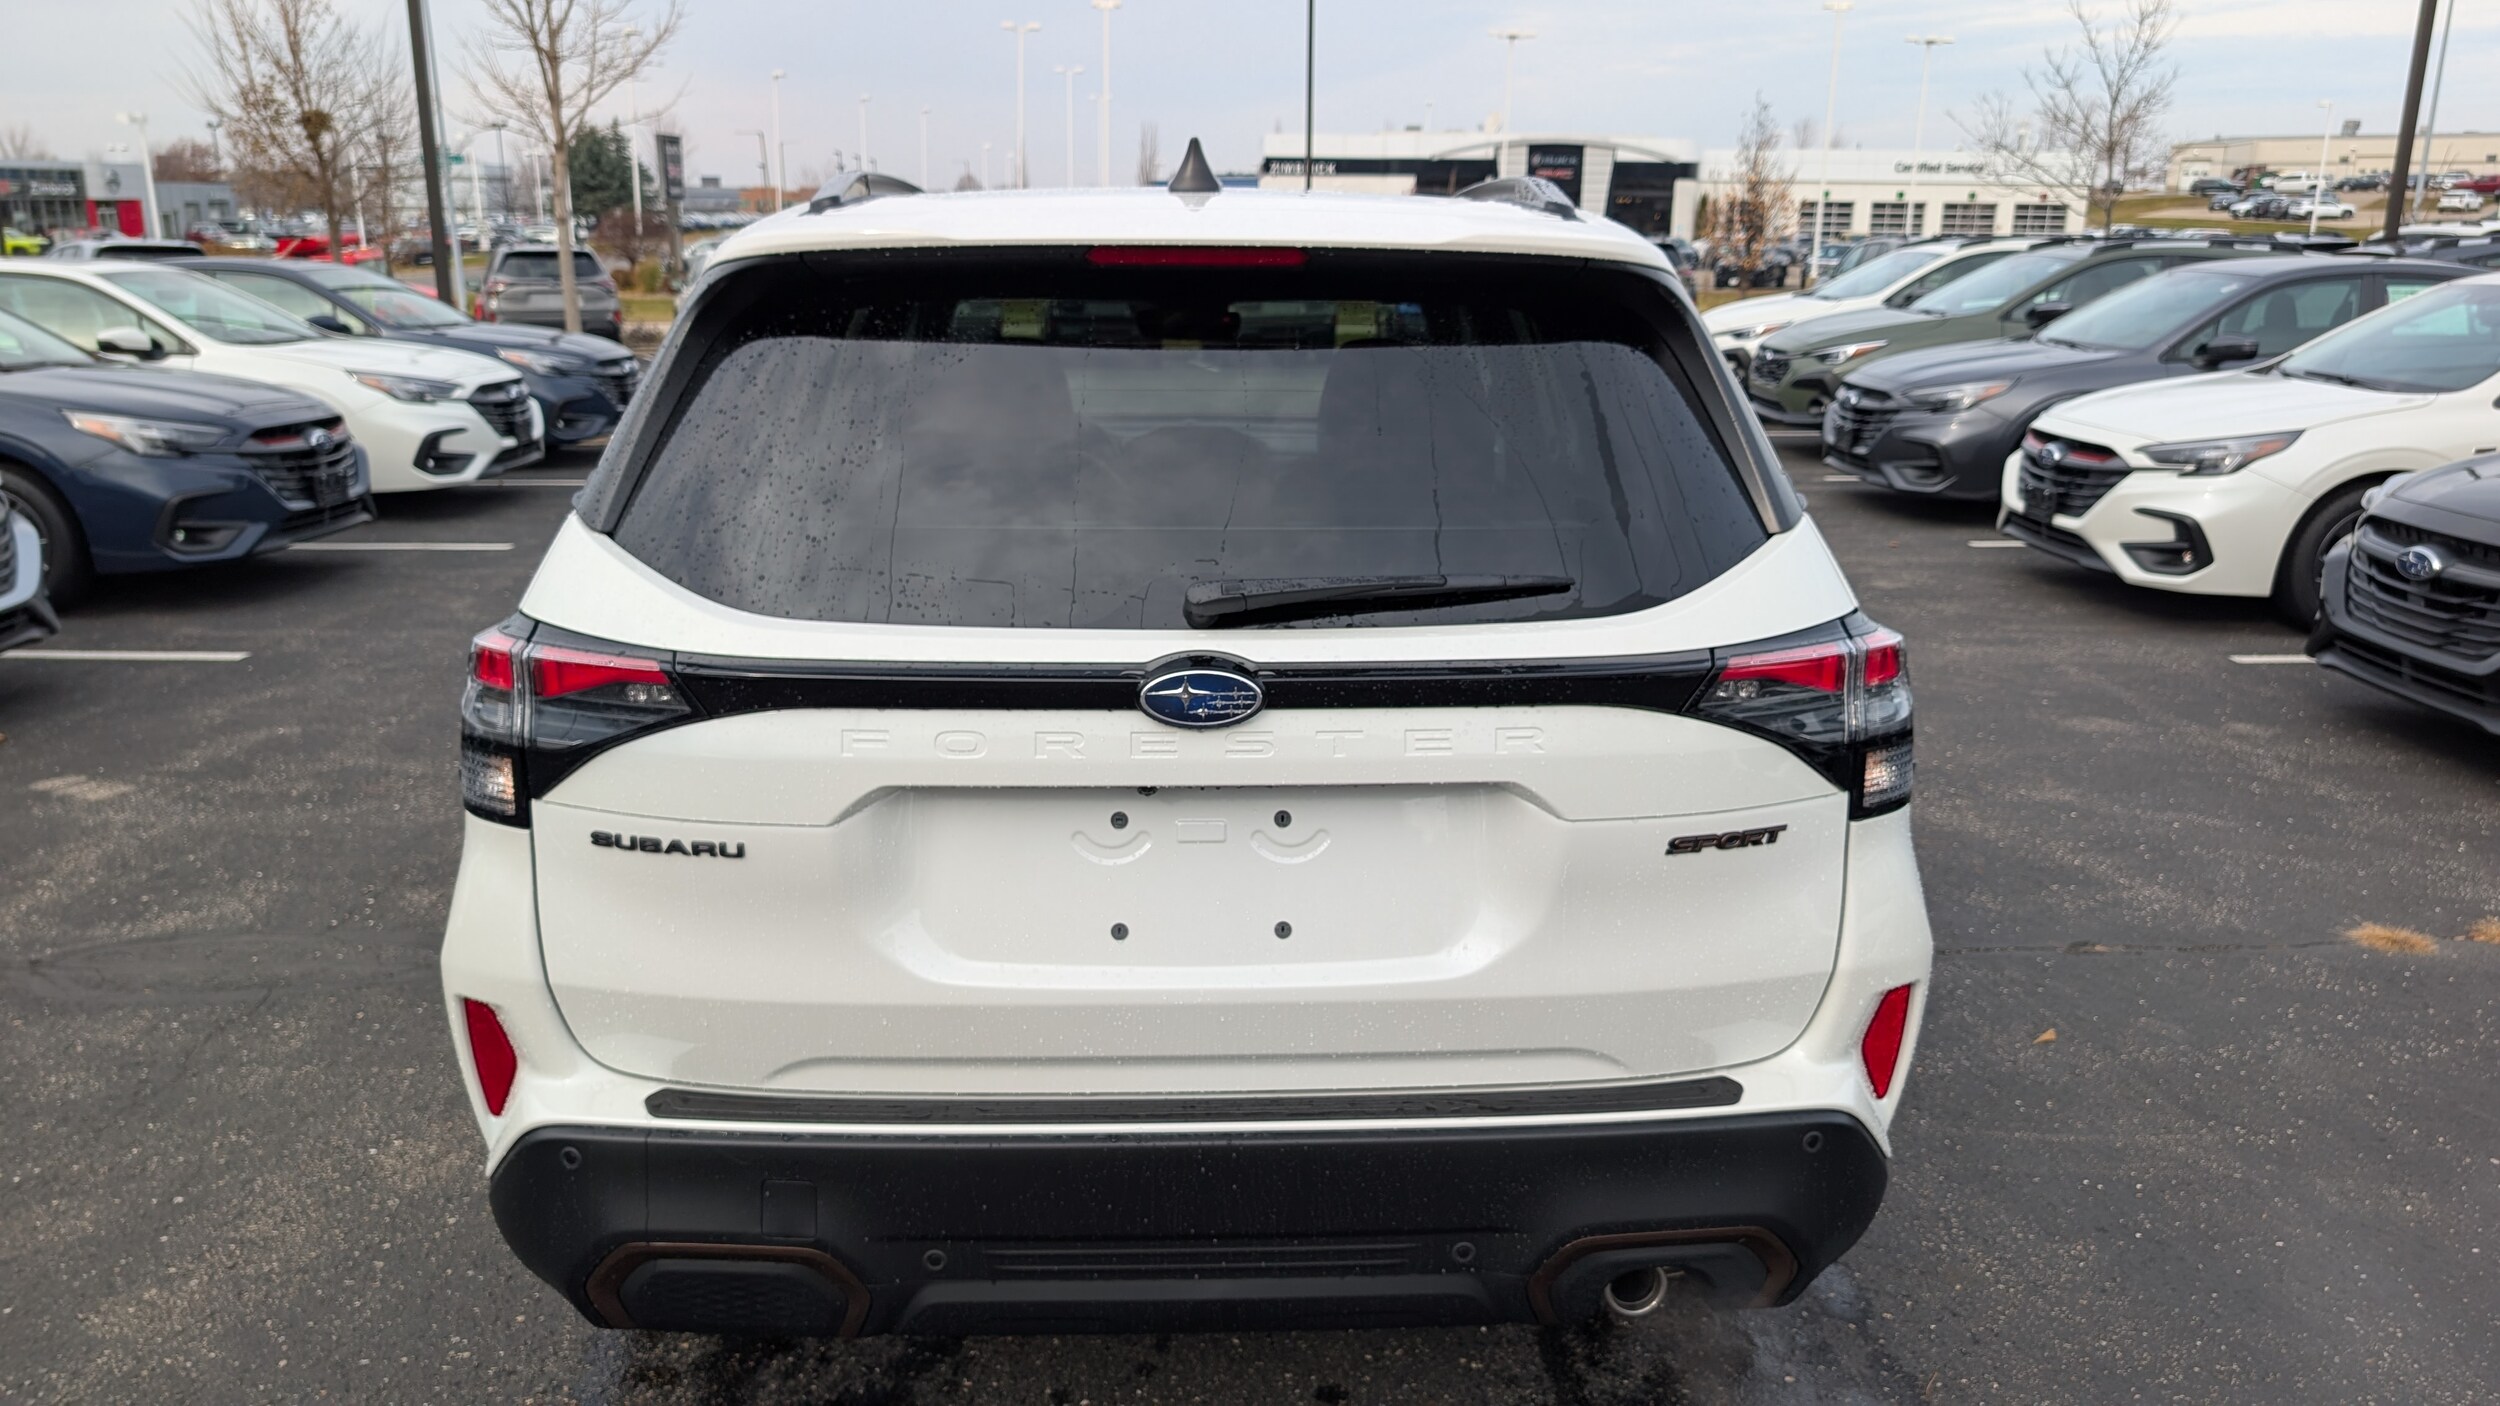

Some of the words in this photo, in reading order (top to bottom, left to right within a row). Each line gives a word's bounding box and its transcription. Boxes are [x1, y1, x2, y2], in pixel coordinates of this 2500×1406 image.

[1269, 161, 1337, 175] ZIMBICK
[1894, 161, 1941, 173] Cerified
[841, 727, 1545, 760] FORESTER
[590, 830, 745, 858] SUBARU
[1665, 824, 1788, 855] SPORT
